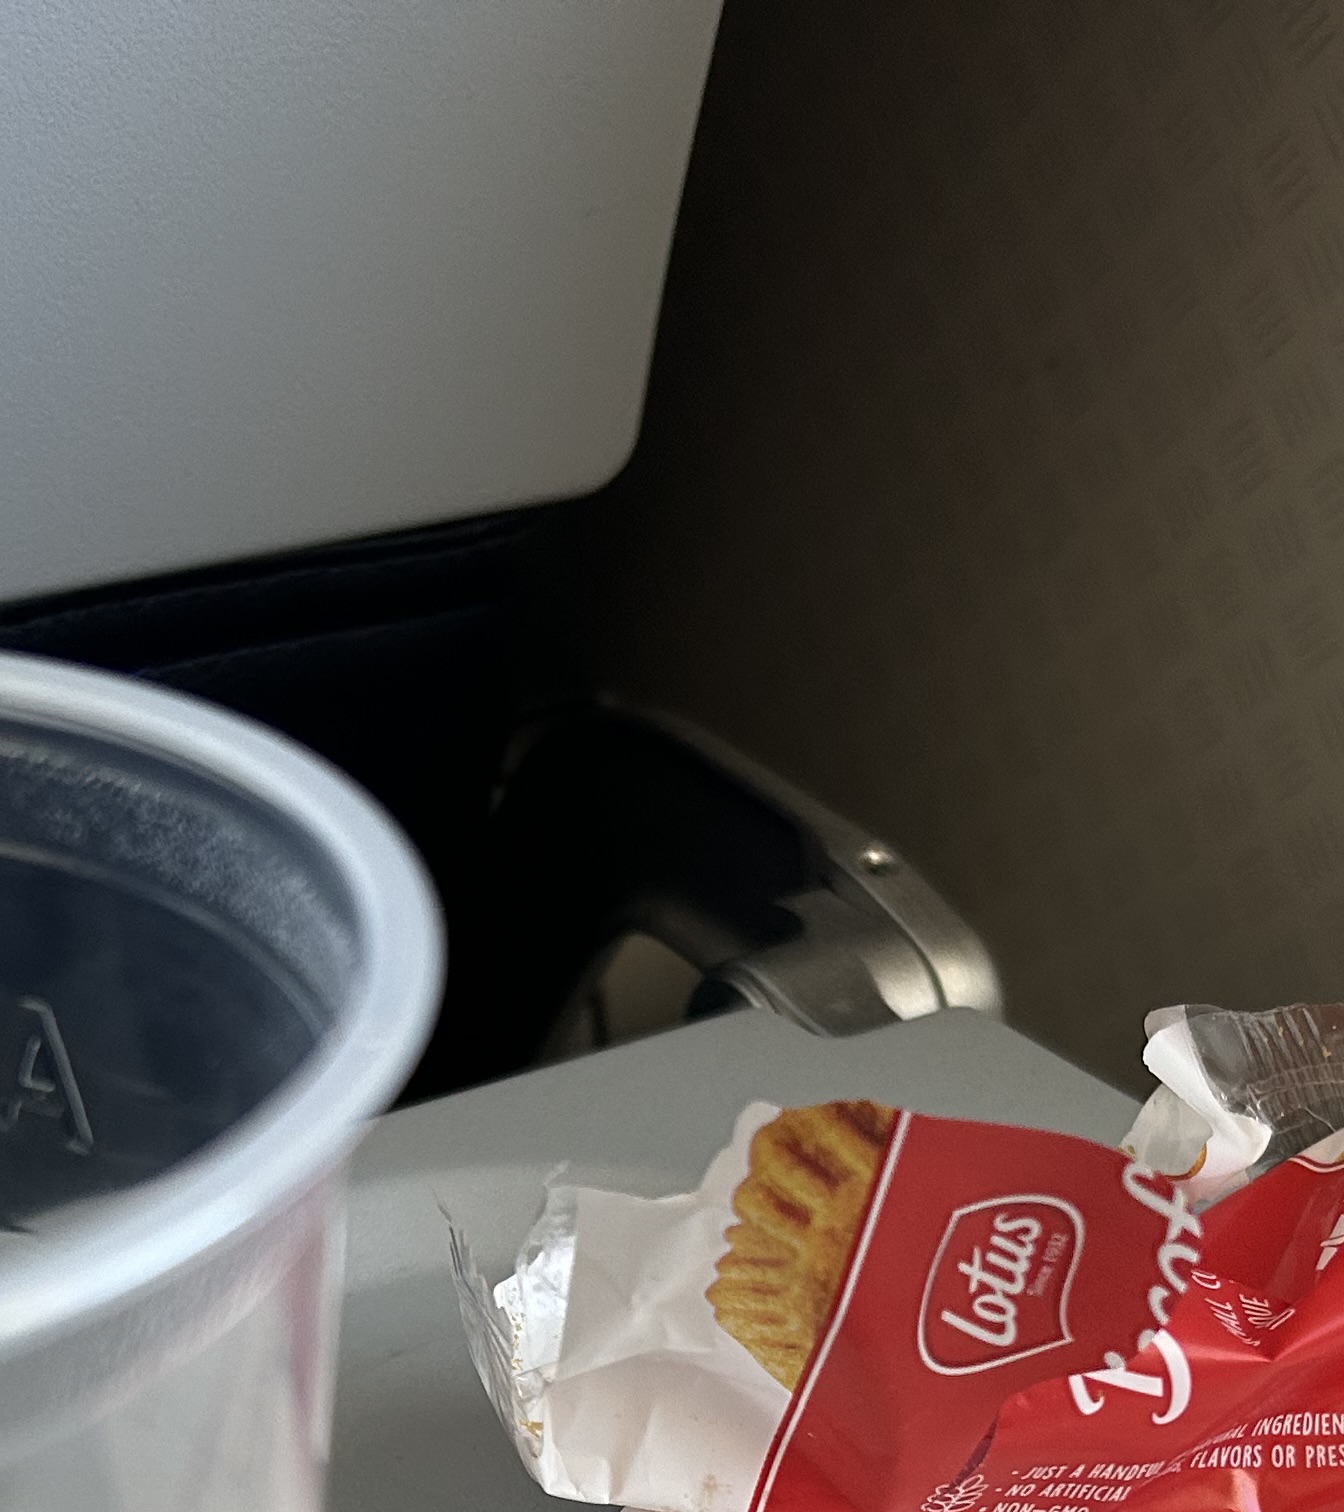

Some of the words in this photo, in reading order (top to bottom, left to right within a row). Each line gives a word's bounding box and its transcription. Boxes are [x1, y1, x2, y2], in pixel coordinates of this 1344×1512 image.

[1190, 1444, 1262, 1470] FLAVORS
[1272, 1445, 1296, 1468] OR
[1021, 1464, 1067, 1480] JUST
[1068, 1464, 1083, 1479] A
[1004, 1484, 1036, 1498] NO
